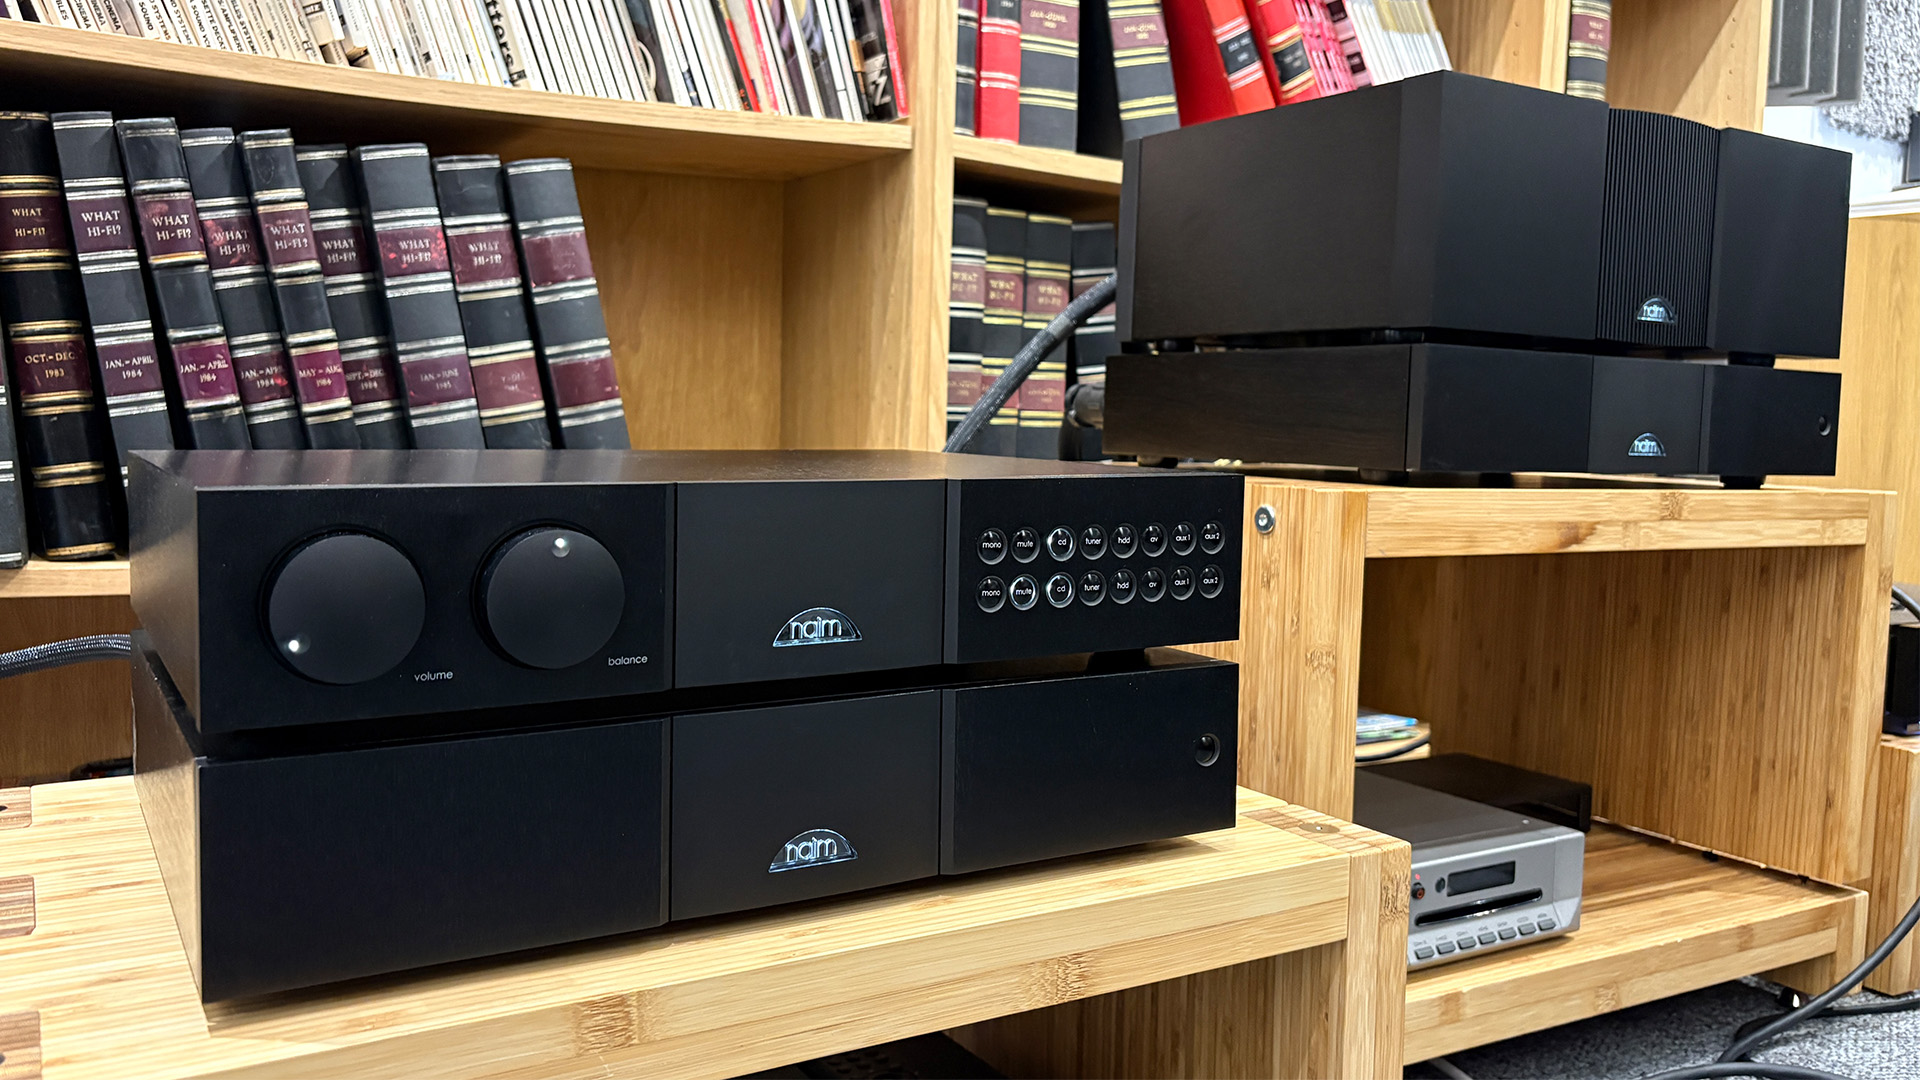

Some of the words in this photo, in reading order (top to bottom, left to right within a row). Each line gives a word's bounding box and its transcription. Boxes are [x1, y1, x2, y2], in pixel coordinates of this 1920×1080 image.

[103, 0, 122, 31] CINEMA
[139, 2, 154, 31] SOUND
[191, 5, 205, 33] SOUND
[152, 4, 172, 41] SYSTEMS
[12, 207, 42, 217] WHAT
[81, 210, 121, 223] WHAT
[151, 214, 190, 227] WHAT
[15, 227, 46, 238] HI-FI?
[87, 224, 122, 237] HI-FI?
[156, 228, 192, 241] HI-FI?
[270, 223, 306, 236] WHAT
[214, 229, 249, 242] WHAT
[219, 243, 251, 256] HI-FI?
[275, 238, 308, 251] HI-FI?
[322, 239, 355, 250] WHAT
[398, 239, 431, 250] WHAT
[1642, 304, 1667, 319] naim
[45, 368, 65, 379] 1983
[122, 369, 143, 380] 1984
[199, 373, 217, 384] 1984
[298, 368, 316, 378] MAY
[316, 378, 332, 387] 1984
[1634, 439, 1658, 453] naim
[982, 541, 1002, 549] mono
[1016, 539, 1034, 549] mute
[1058, 537, 1067, 546] cd
[1085, 537, 1101, 546] tuner
[1118, 536, 1131, 545] hdd
[1015, 586, 1032, 595] mute
[1057, 584, 1066, 592] cd
[1084, 583, 1100, 591] tuner
[1116, 581, 1130, 590] hdd
[981, 589, 1001, 597] mono
[789, 616, 842, 640] naim
[608, 654, 648, 667] balance
[414, 669, 454, 683] volume
[784, 836, 838, 863] naim
